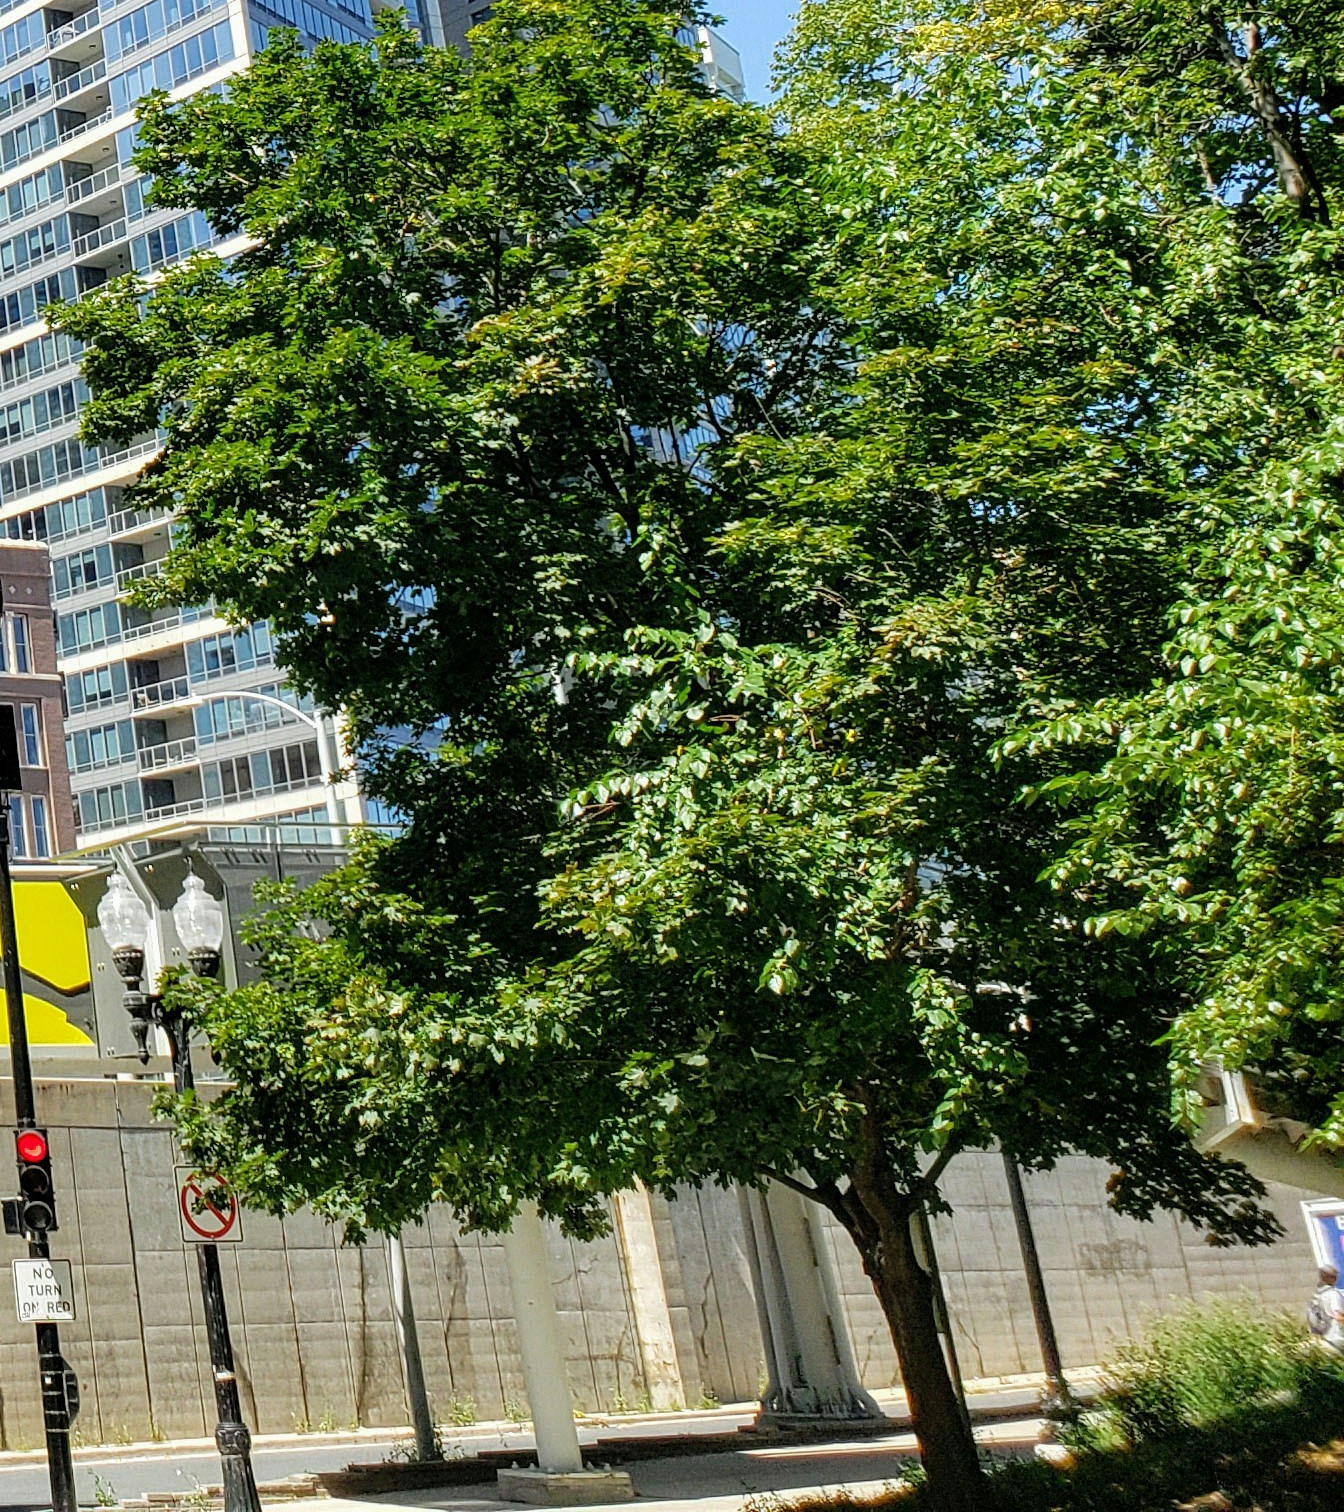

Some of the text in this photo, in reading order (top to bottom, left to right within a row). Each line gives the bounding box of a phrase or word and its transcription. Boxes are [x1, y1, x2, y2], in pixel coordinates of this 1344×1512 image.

[33, 1268, 54, 1279] NO
[28, 1284, 62, 1296] TURN
[23, 1301, 71, 1313] ON RED
